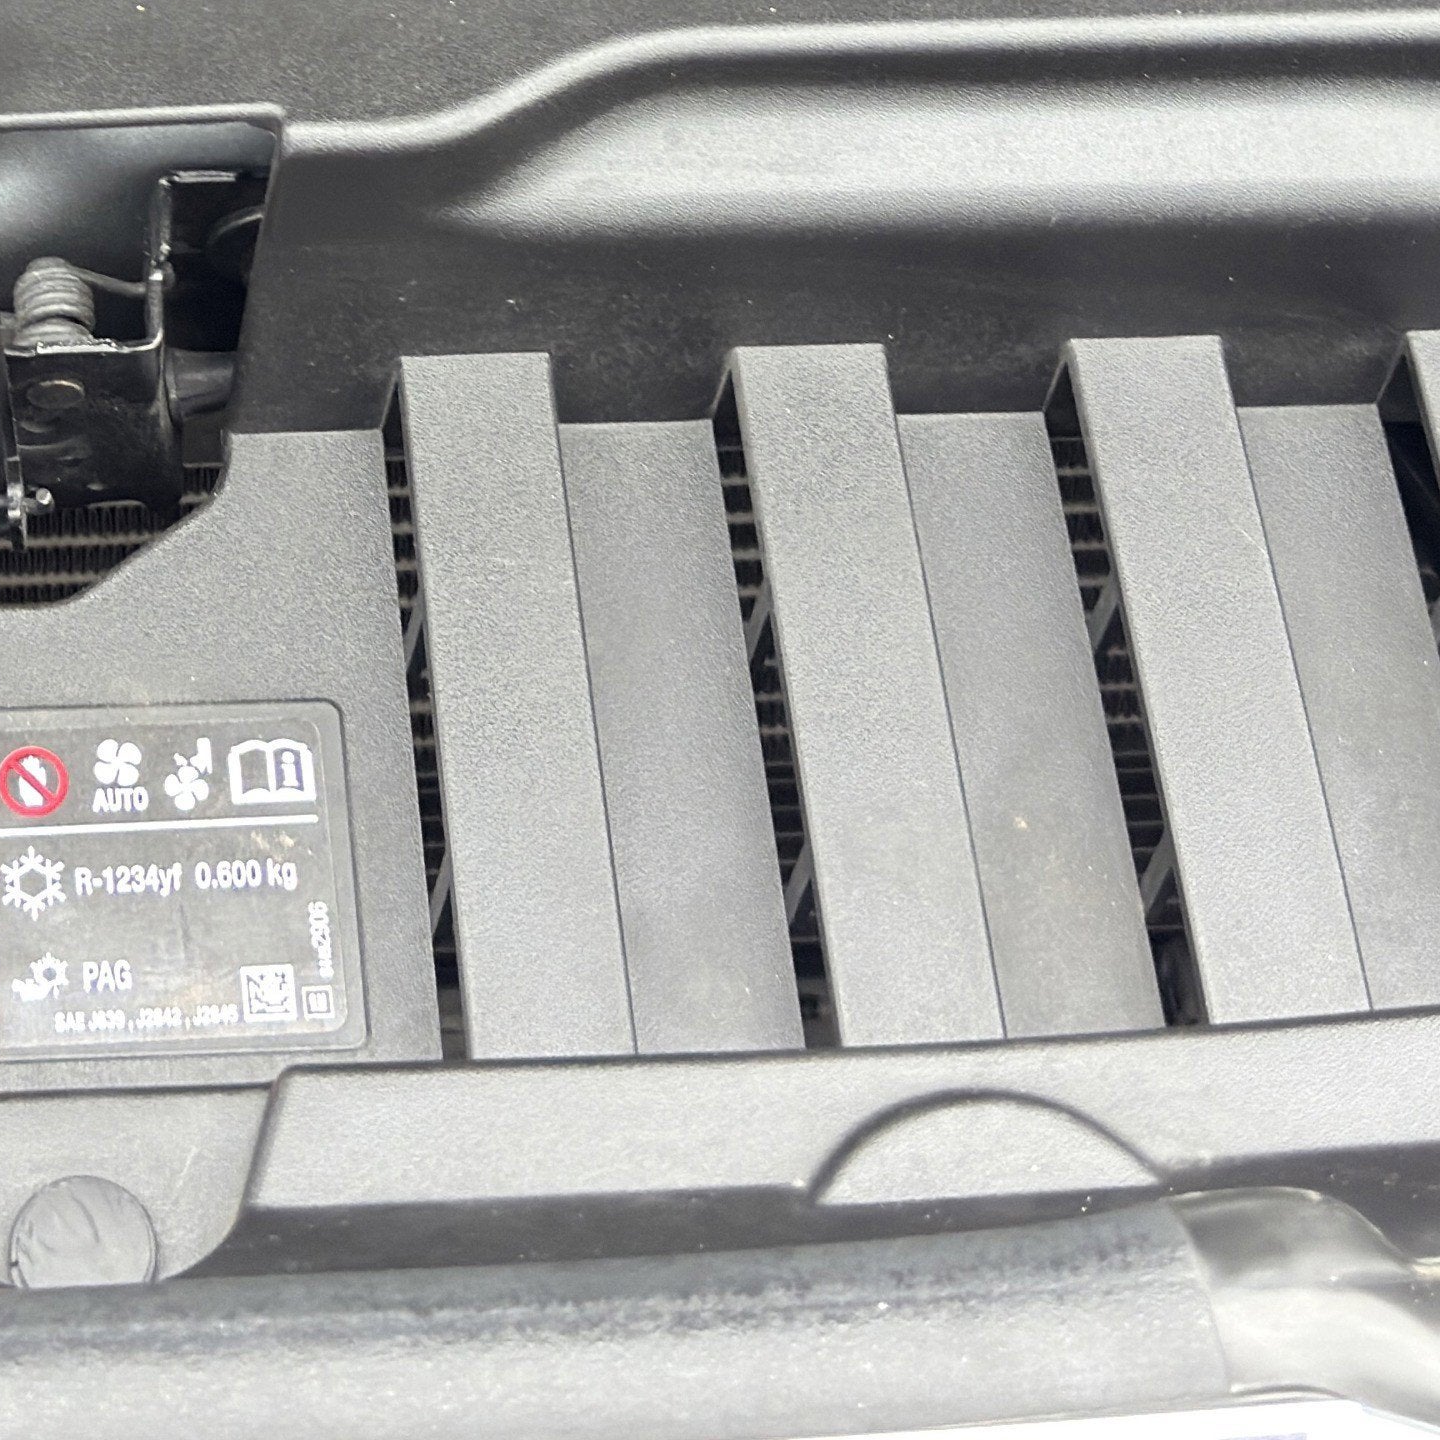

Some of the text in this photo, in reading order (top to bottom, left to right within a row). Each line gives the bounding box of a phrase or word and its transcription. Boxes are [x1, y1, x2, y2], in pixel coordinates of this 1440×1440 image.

[93, 786, 149, 813] AUTO
[75, 858, 298, 897] R-1234yf 0.600 kg
[82, 960, 133, 993] PAG
